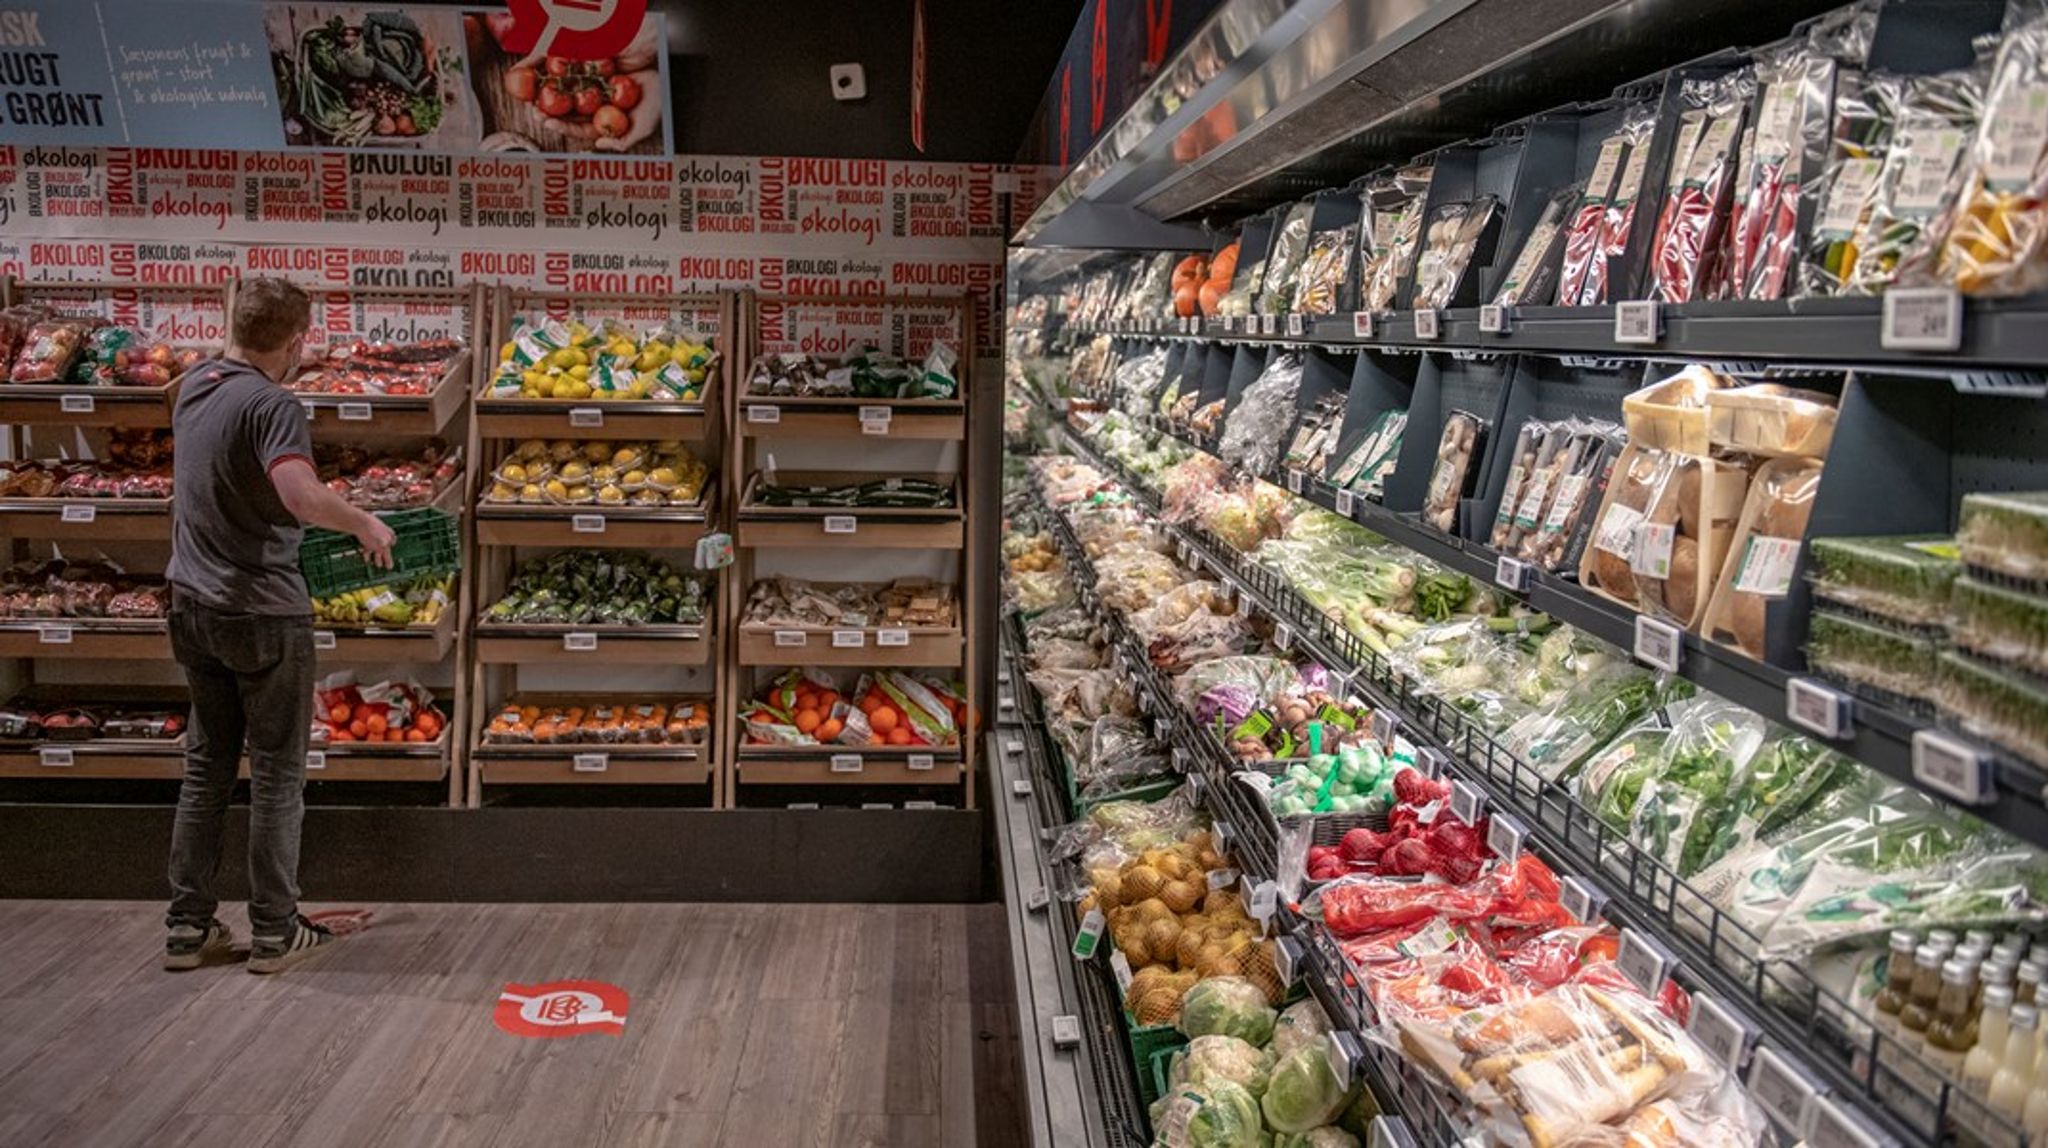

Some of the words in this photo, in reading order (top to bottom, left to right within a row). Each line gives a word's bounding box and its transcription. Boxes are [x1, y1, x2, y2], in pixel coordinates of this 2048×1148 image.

[193, 41, 234, 67] frugt
[179, 63, 214, 83] stort
[217, 84, 268, 109] udvalg
[5, 90, 104, 127] GRØNT
[22, 145, 99, 178] økologi
[135, 149, 238, 170] ØKOLOGI
[245, 151, 316, 183] økologi
[350, 153, 452, 176] ØKOLOGI
[572, 159, 673, 182] ØKOLOGI
[106, 147, 133, 205] ØKOL
[322, 153, 349, 211] ØKOL
[458, 157, 530, 190] økologi
[678, 160, 751, 194] økologi
[787, 158, 886, 186] ØKOLOGI
[891, 165, 963, 199] økologi
[836, 189, 883, 204] ØKOLOGI
[46, 200, 103, 217] ØKOLOGI
[152, 190, 233, 229] økologi
[263, 204, 322, 222] ØKOLOGI
[366, 196, 448, 235] økologi
[478, 210, 535, 228] ØKOLOGI
[910, 204, 955, 219] ØKOLOGI
[587, 201, 668, 240] økologi
[697, 215, 755, 233] ØKOLOGI
[801, 206, 881, 245] økologi
[911, 219, 967, 237] ØKOLOGI
[30, 244, 104, 266] ØKOLOGI
[138, 244, 191, 261] ØKOLOGI
[247, 248, 322, 270] ØKOLOGI
[351, 248, 404, 265] ØKOLOGI
[461, 252, 536, 275] ØKOLOGI
[572, 254, 624, 270] ØKOLOGI
[680, 257, 754, 279] ØKOLOGI
[786, 259, 837, 275] ØKOLOGI
[893, 262, 965, 285] ØKOLOGI
[110, 244, 138, 325] ØKOOGI
[324, 248, 351, 332] ØKOOGI
[759, 257, 784, 341] ØKOOGI
[836, 311, 883, 325] ØKOLOGI
